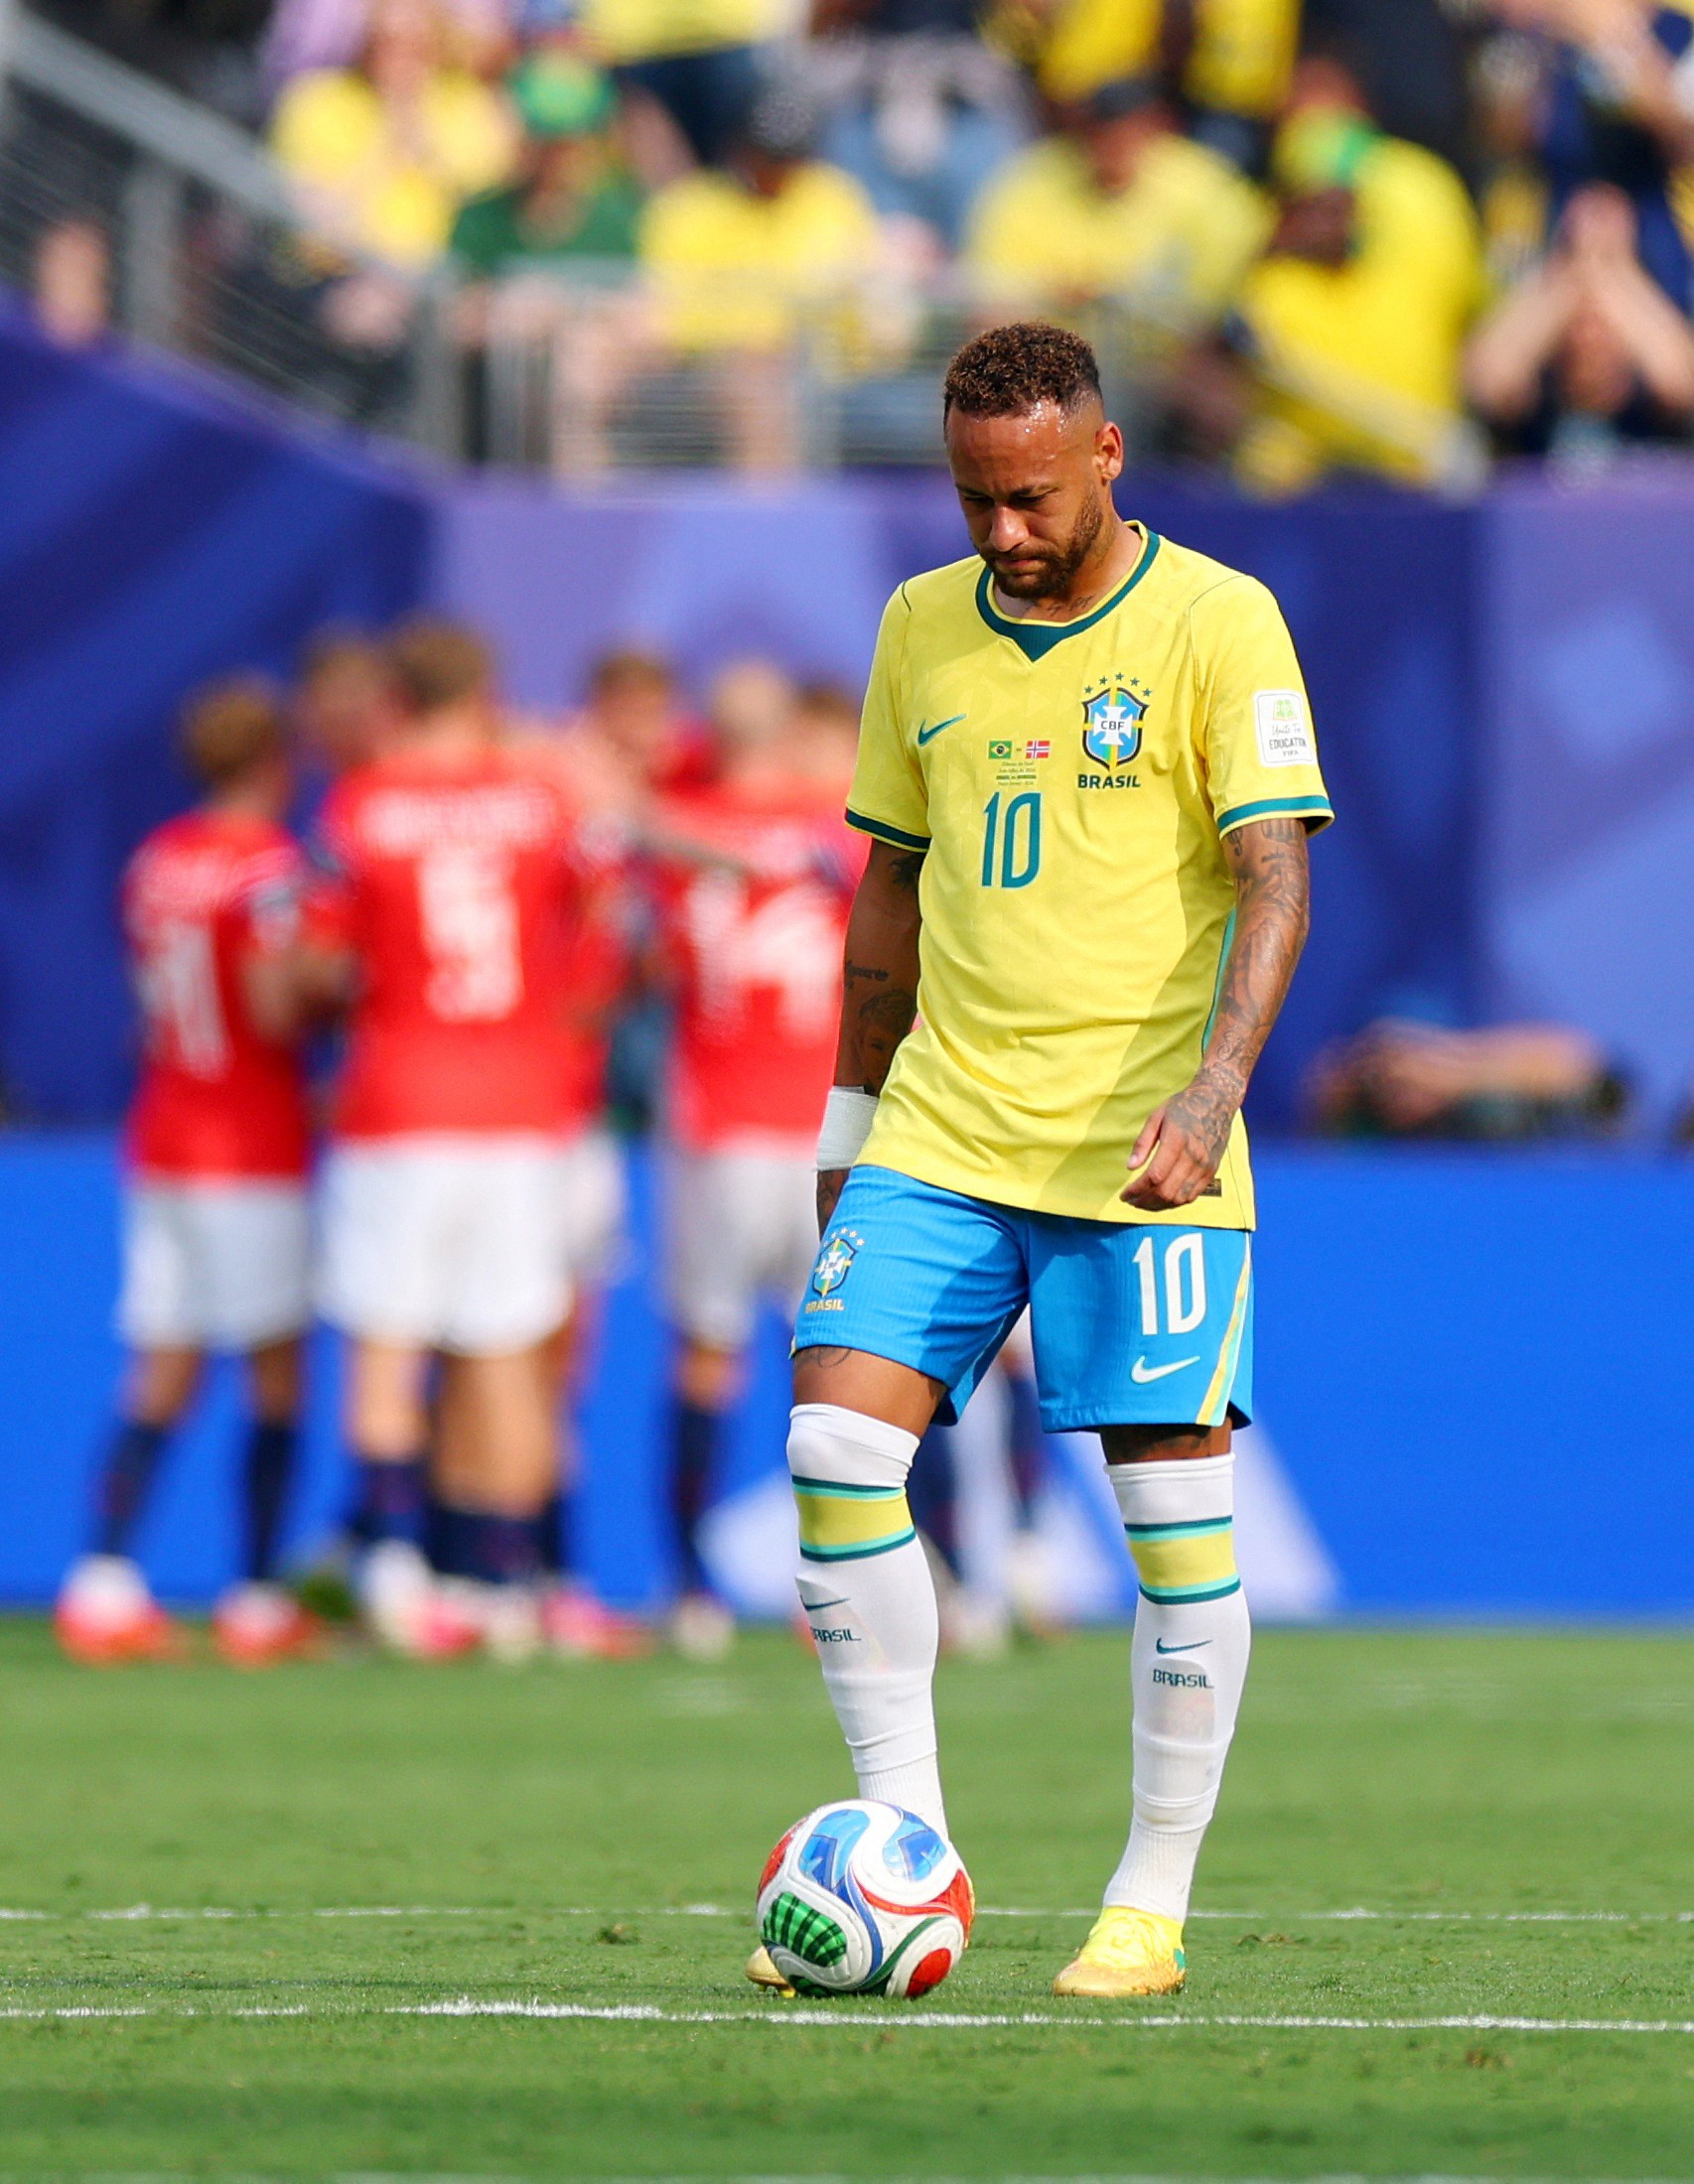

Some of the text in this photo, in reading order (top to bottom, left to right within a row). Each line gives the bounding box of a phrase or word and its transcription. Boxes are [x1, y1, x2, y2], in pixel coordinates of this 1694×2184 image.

[1100, 720, 1125, 732] CBF
[1077, 774, 1142, 789] BRASIL
[981, 791, 1042, 888] 10
[1132, 1232, 1207, 1336] 10
[804, 1298, 846, 1314] BRASIL
[1152, 1669, 1215, 1690] BRASIL
